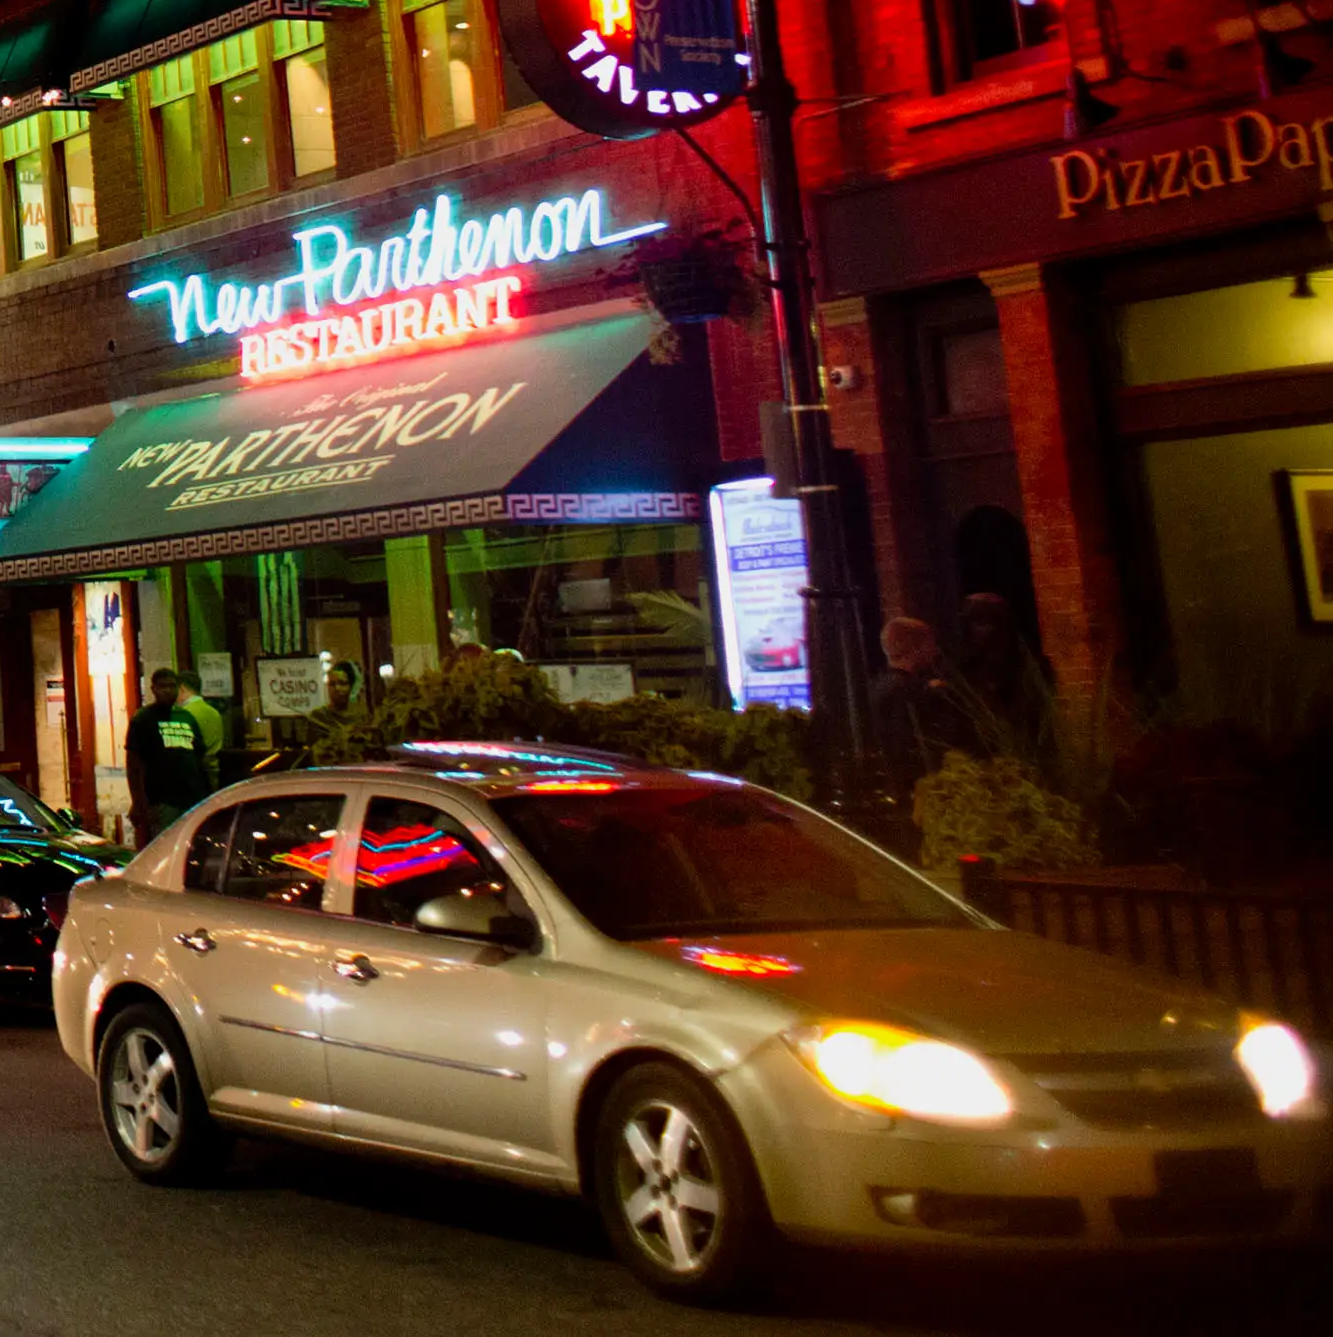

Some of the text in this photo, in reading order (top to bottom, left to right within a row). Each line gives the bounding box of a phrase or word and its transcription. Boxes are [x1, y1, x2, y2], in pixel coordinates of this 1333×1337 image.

[128, 188, 668, 344] New Parthenon
[239, 276, 521, 378] RESTAURANT
[116, 382, 528, 489] NEW PARTHENON
[171, 460, 391, 507] RESTAURANT
[269, 679, 319, 695] CASINO
